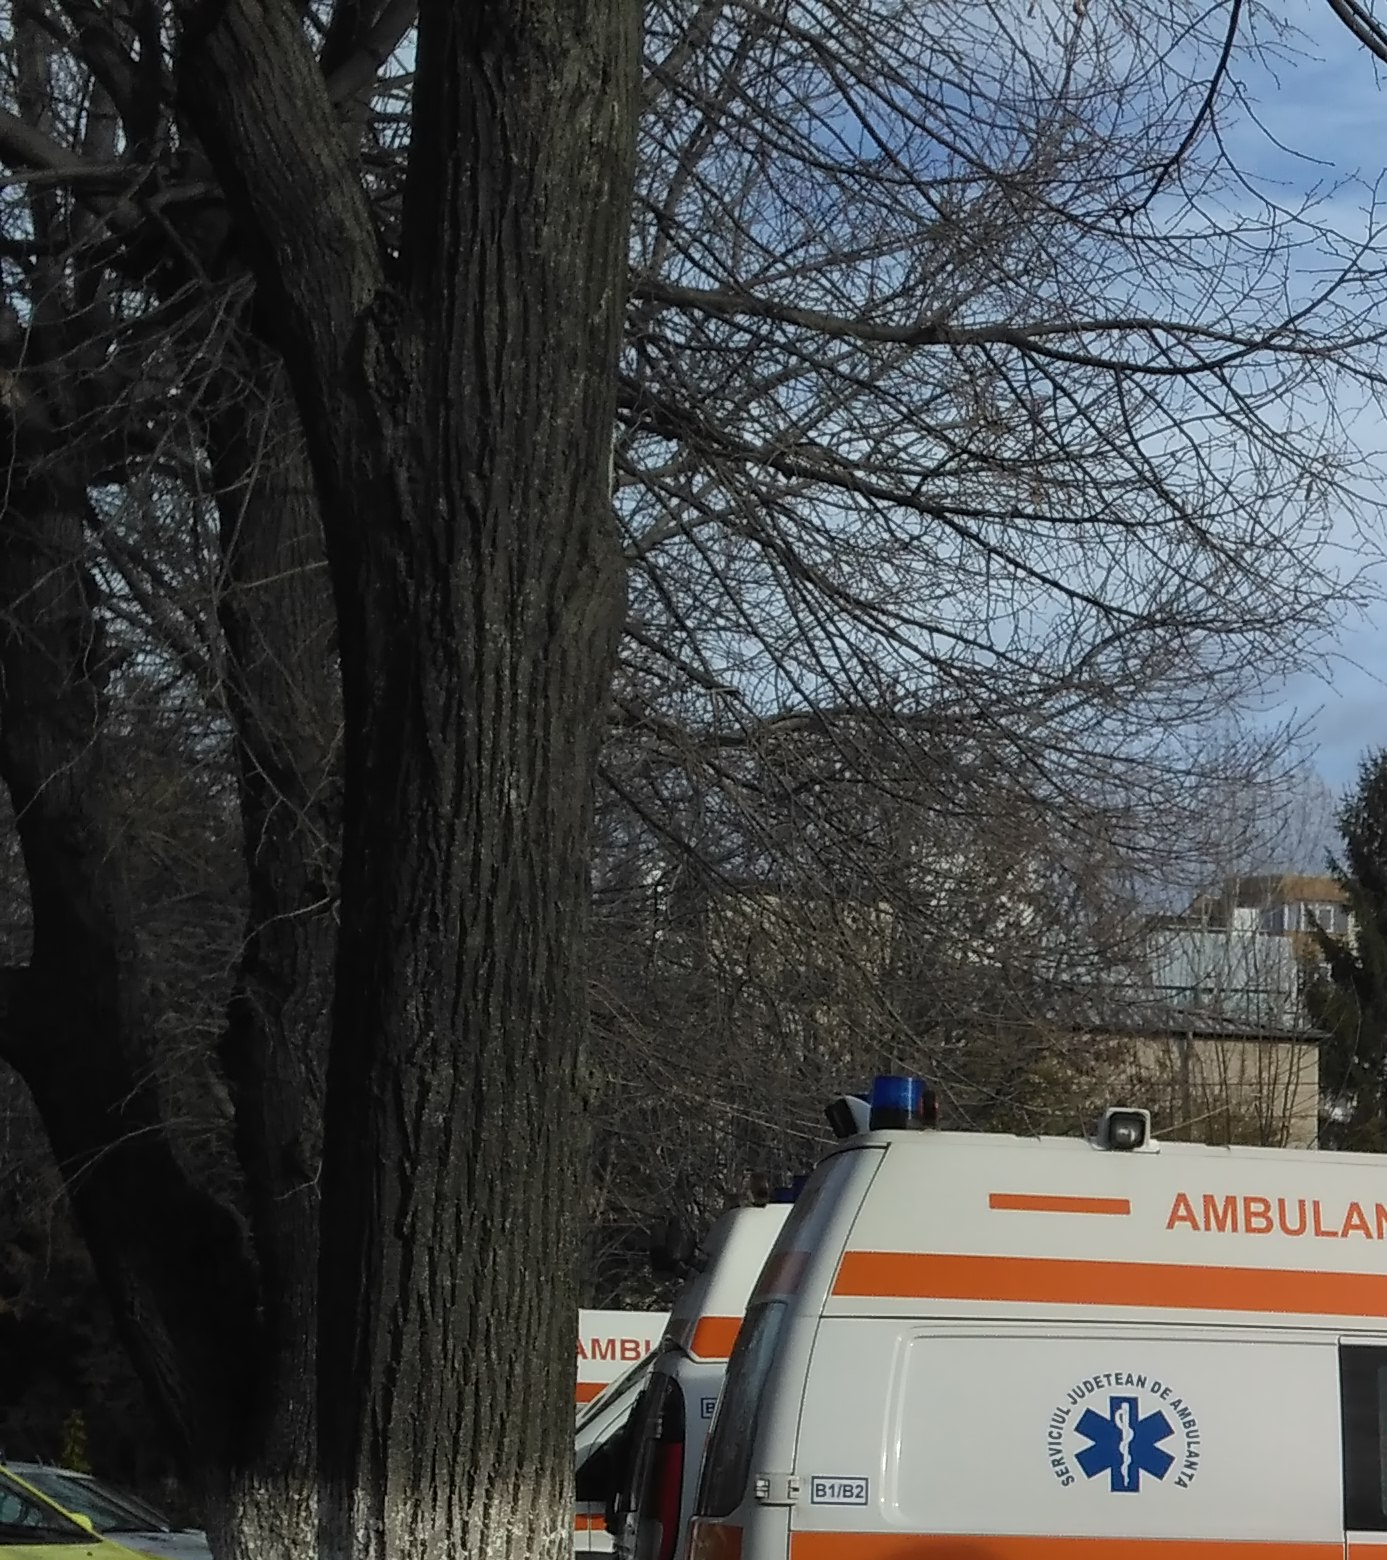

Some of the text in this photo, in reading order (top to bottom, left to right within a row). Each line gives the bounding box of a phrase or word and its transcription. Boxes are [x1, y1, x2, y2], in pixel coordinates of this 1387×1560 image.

[1048, 1373, 1201, 1488] SERVICIUL JUDETEAN DE AMBULANTA
[814, 1481, 865, 1500] B1/B2
